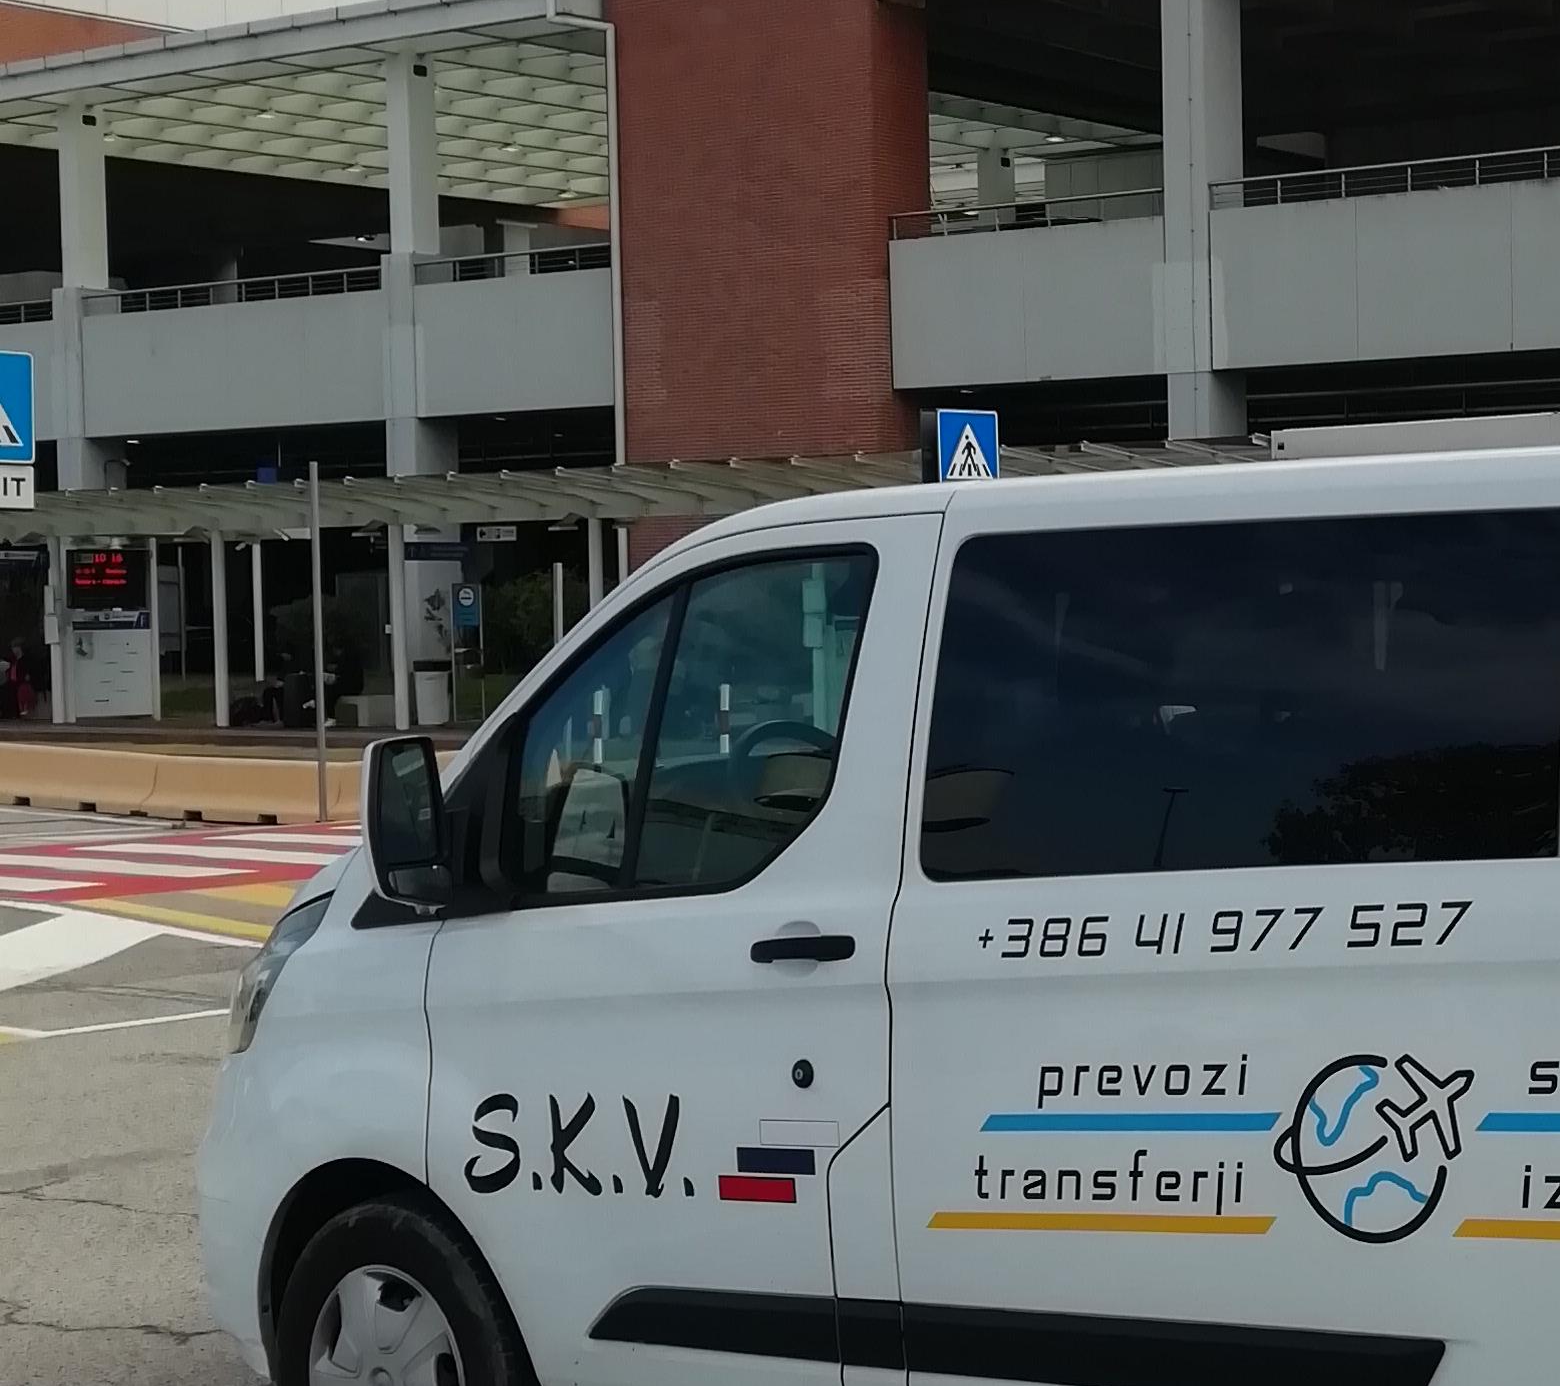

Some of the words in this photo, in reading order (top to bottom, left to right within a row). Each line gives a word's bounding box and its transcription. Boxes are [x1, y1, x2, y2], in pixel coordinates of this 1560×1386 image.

[3, 476, 26, 497] IT
[977, 915, 1110, 959] +386
[1135, 912, 1185, 955] 41
[1210, 906, 1325, 953] 977
[1346, 900, 1473, 948] 527
[1037, 1053, 1249, 1109] prevozi
[463, 1092, 697, 1199] S.K.V.
[973, 1148, 1244, 1216] transferji
